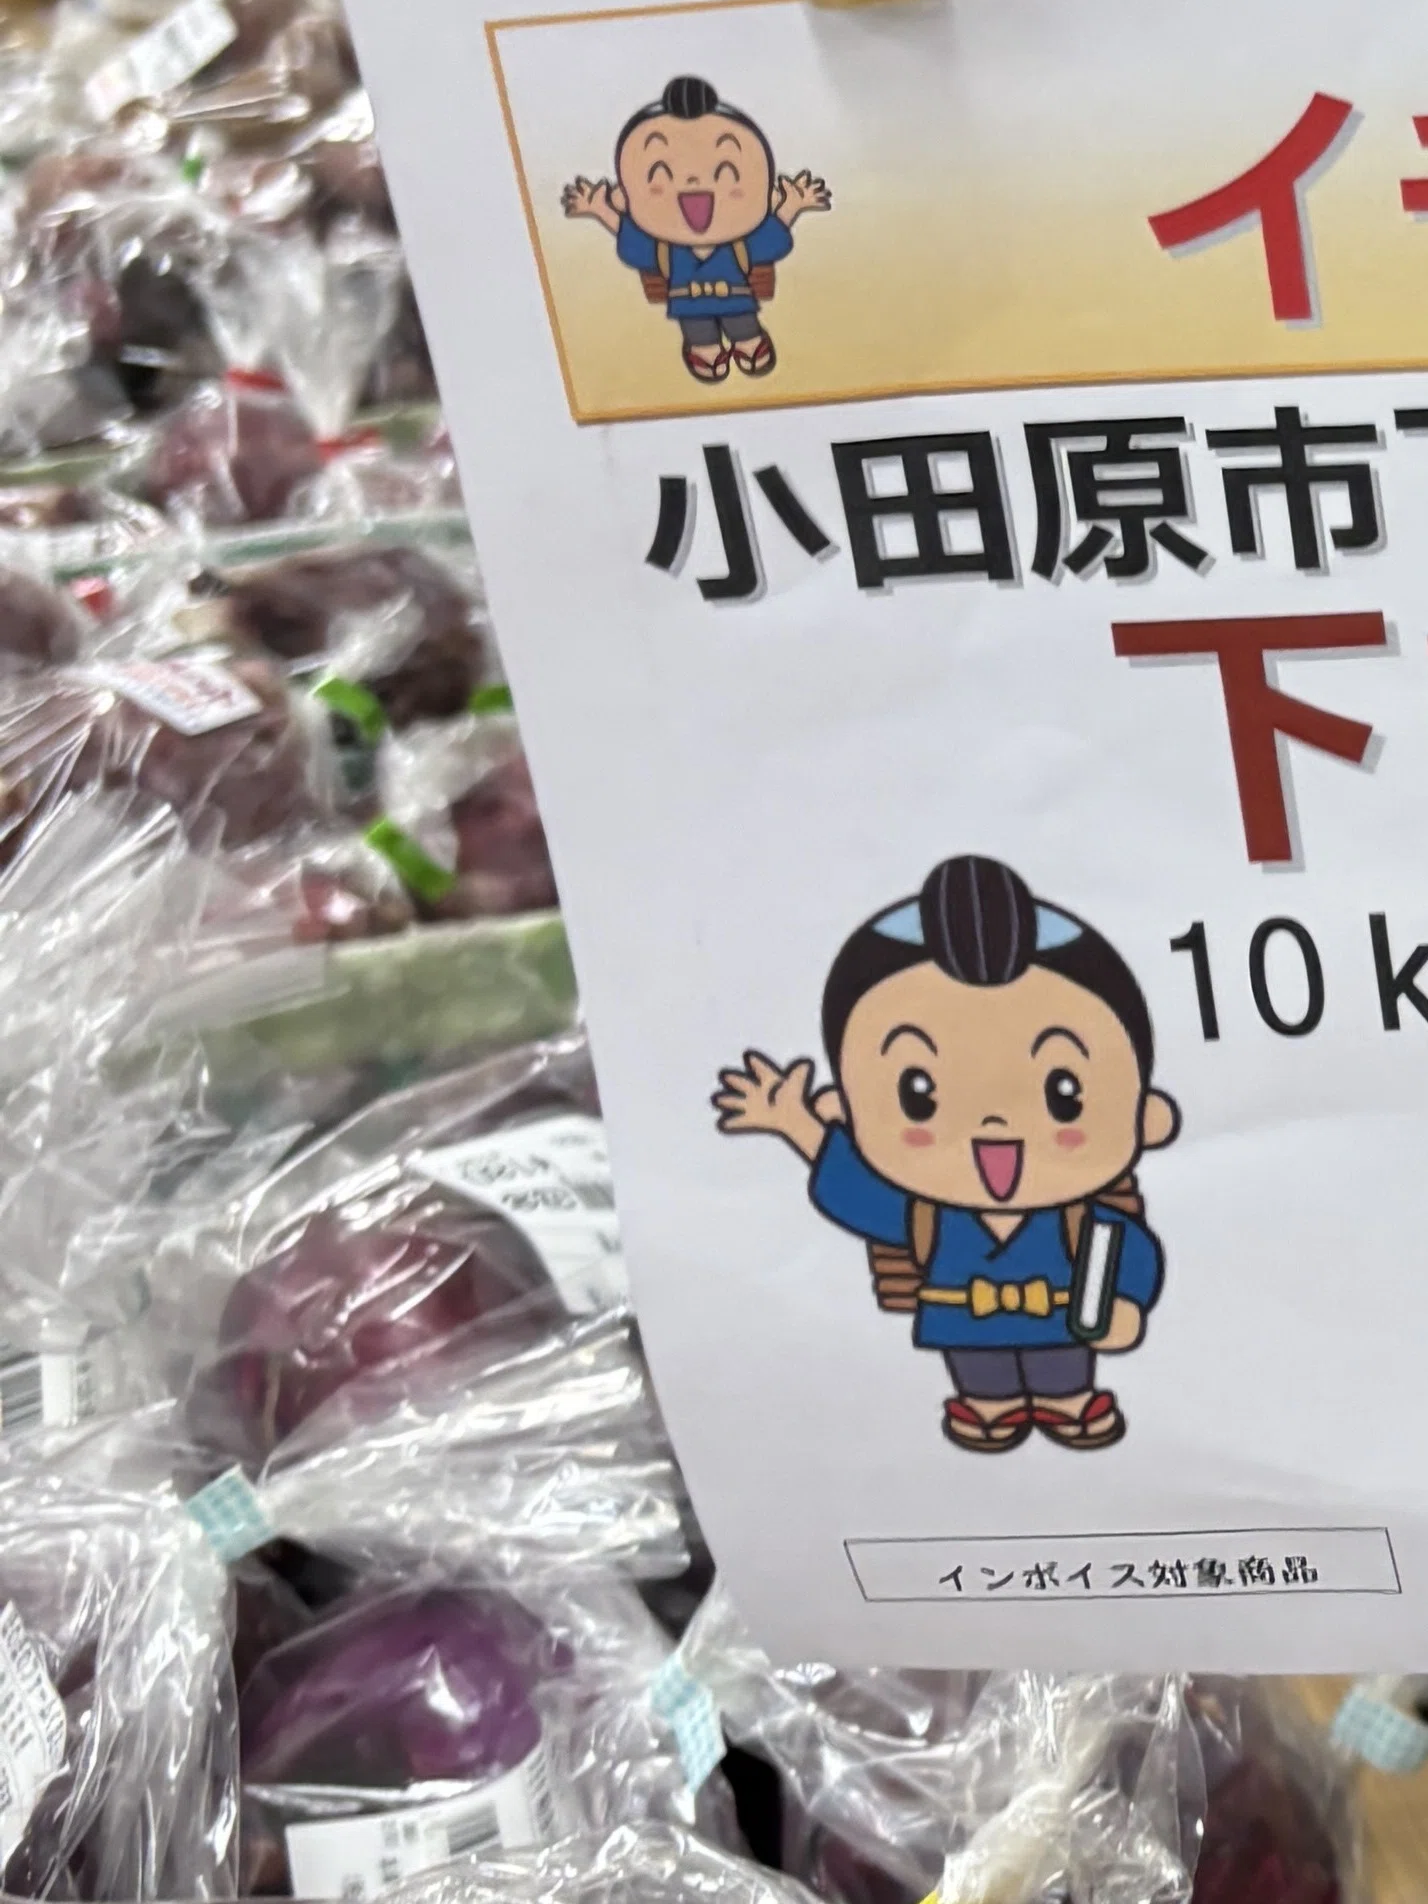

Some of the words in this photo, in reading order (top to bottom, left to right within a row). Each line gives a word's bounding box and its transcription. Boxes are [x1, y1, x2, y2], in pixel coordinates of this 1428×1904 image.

[1170, 916, 1325, 1042] 10
[938, 1554, 1318, 1593] インボイス対象商品
